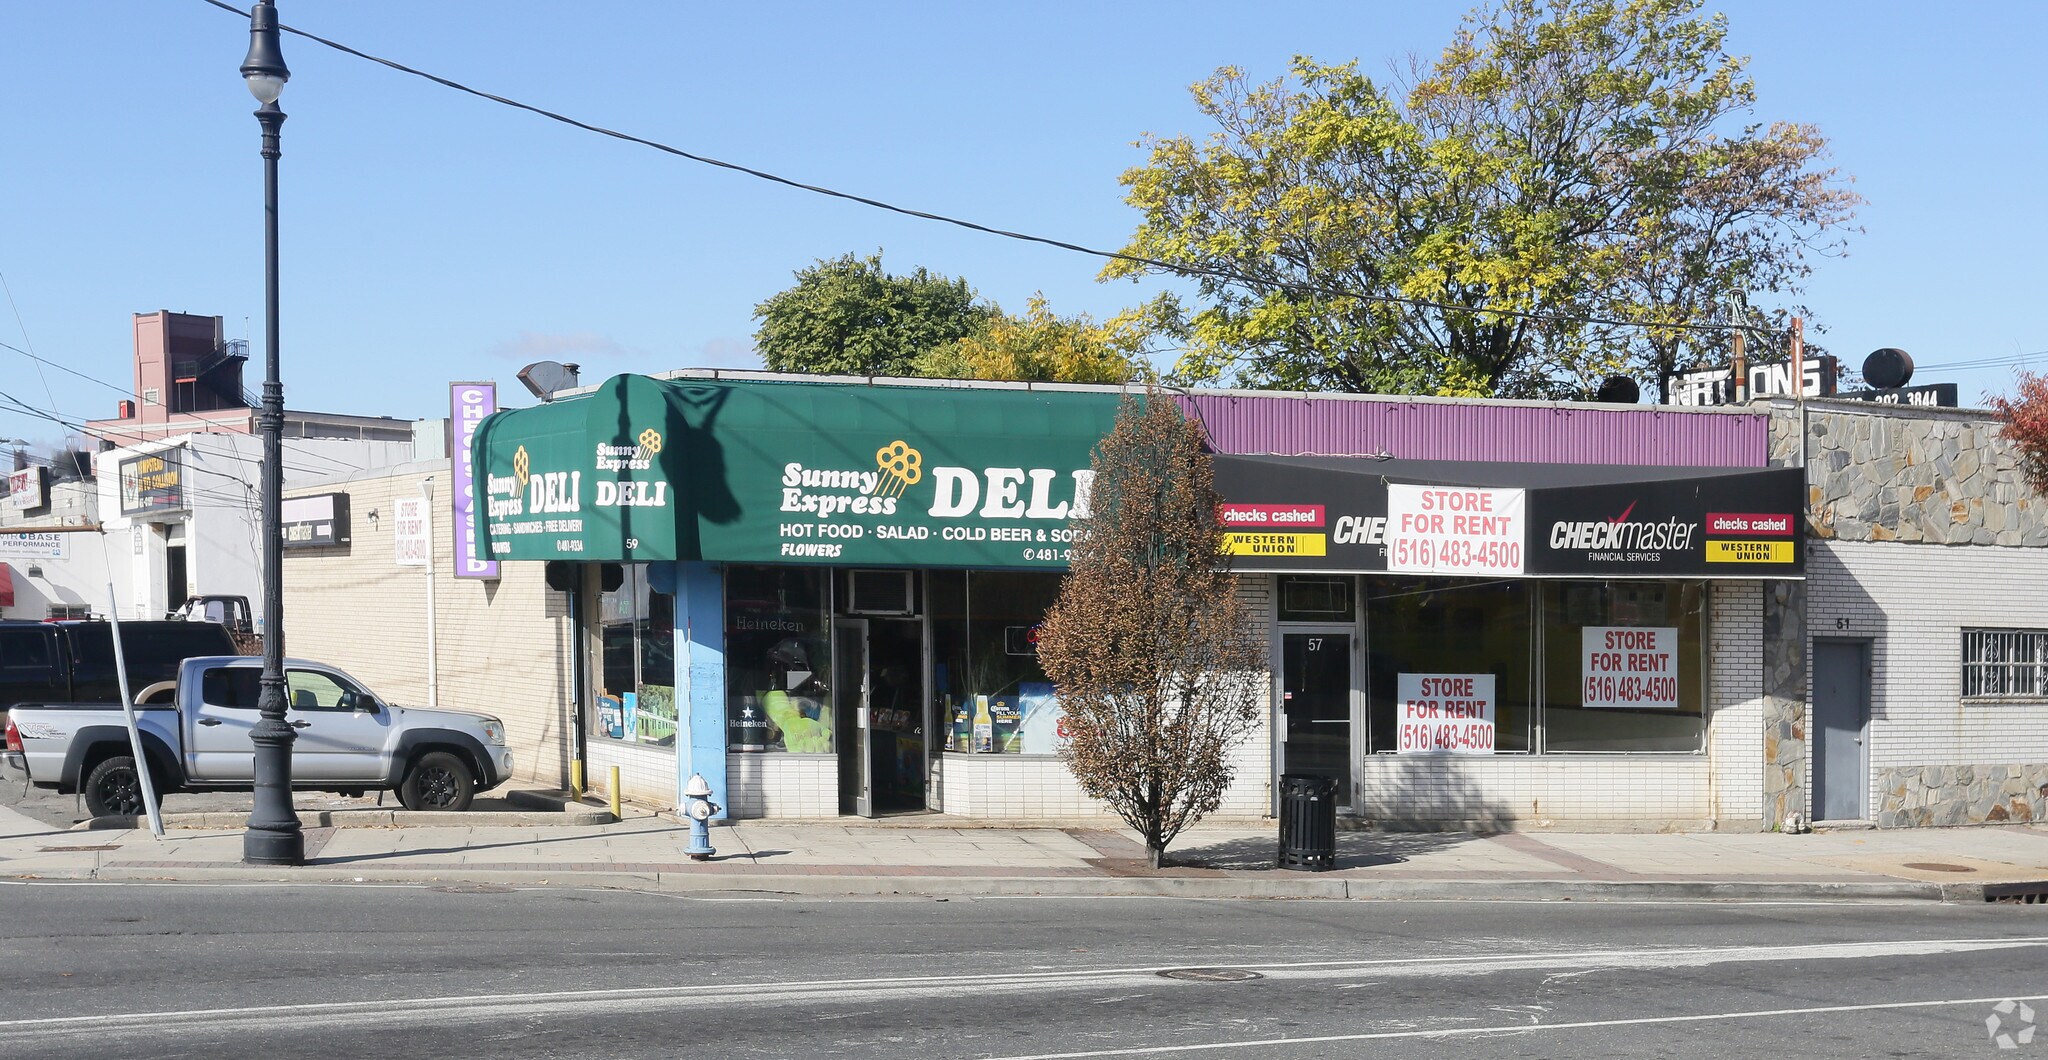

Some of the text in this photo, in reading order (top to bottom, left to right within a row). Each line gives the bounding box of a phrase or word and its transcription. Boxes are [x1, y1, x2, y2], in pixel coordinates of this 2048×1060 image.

[1668, 359, 1820, 406] NATONS
[596, 442, 641, 459] Sunny
[595, 456, 650, 472] Express
[487, 473, 516, 498] Sunny
[782, 462, 878, 494] Sunny
[529, 471, 581, 514] DELI
[595, 481, 667, 506] DELI
[927, 467, 1098, 520] DELI
[1421, 491, 1492, 512] STORE
[487, 495, 523, 521] Express
[780, 488, 897, 518] Express
[1223, 509, 1316, 522] checks cashed
[1401, 513, 1511, 536] FOR RENT
[1713, 518, 1786, 531] checks cashed
[489, 519, 583, 536] CATERING SANDWICHES FREE DELIVERY
[779, 523, 814, 537] HOT
[818, 524, 864, 538] FOOD
[876, 525, 929, 540] SALAD
[942, 527, 986, 541] COLD
[990, 528, 1032, 542] BEER
[1035, 529, 1047, 542] &
[1333, 515, 1388, 545] CHE
[1550, 516, 1698, 550] CHECKmaster
[3, 540, 61, 549] PERFORMANCE
[626, 538, 639, 549] 59
[1233, 536, 1295, 544] WESTERN
[1253, 545, 1295, 553] UNION
[1721, 543, 1770, 552] WESTERN
[781, 543, 843, 557] FLOWERS
[1588, 552, 1661, 562] FINANCIAL SERVICES
[1736, 552, 1770, 560] UNION
[736, 616, 805, 632] Heineken
[1308, 638, 1323, 651] 57
[1605, 631, 1656, 650] STORE
[1591, 653, 1669, 672] FOR RENT
[1421, 678, 1474, 697] STORE
[1618, 677, 1676, 702] 483-4500
[1406, 700, 1487, 719] FOR RENT
[729, 719, 768, 728] Heineken
[1435, 724, 1493, 750] 483-4500
